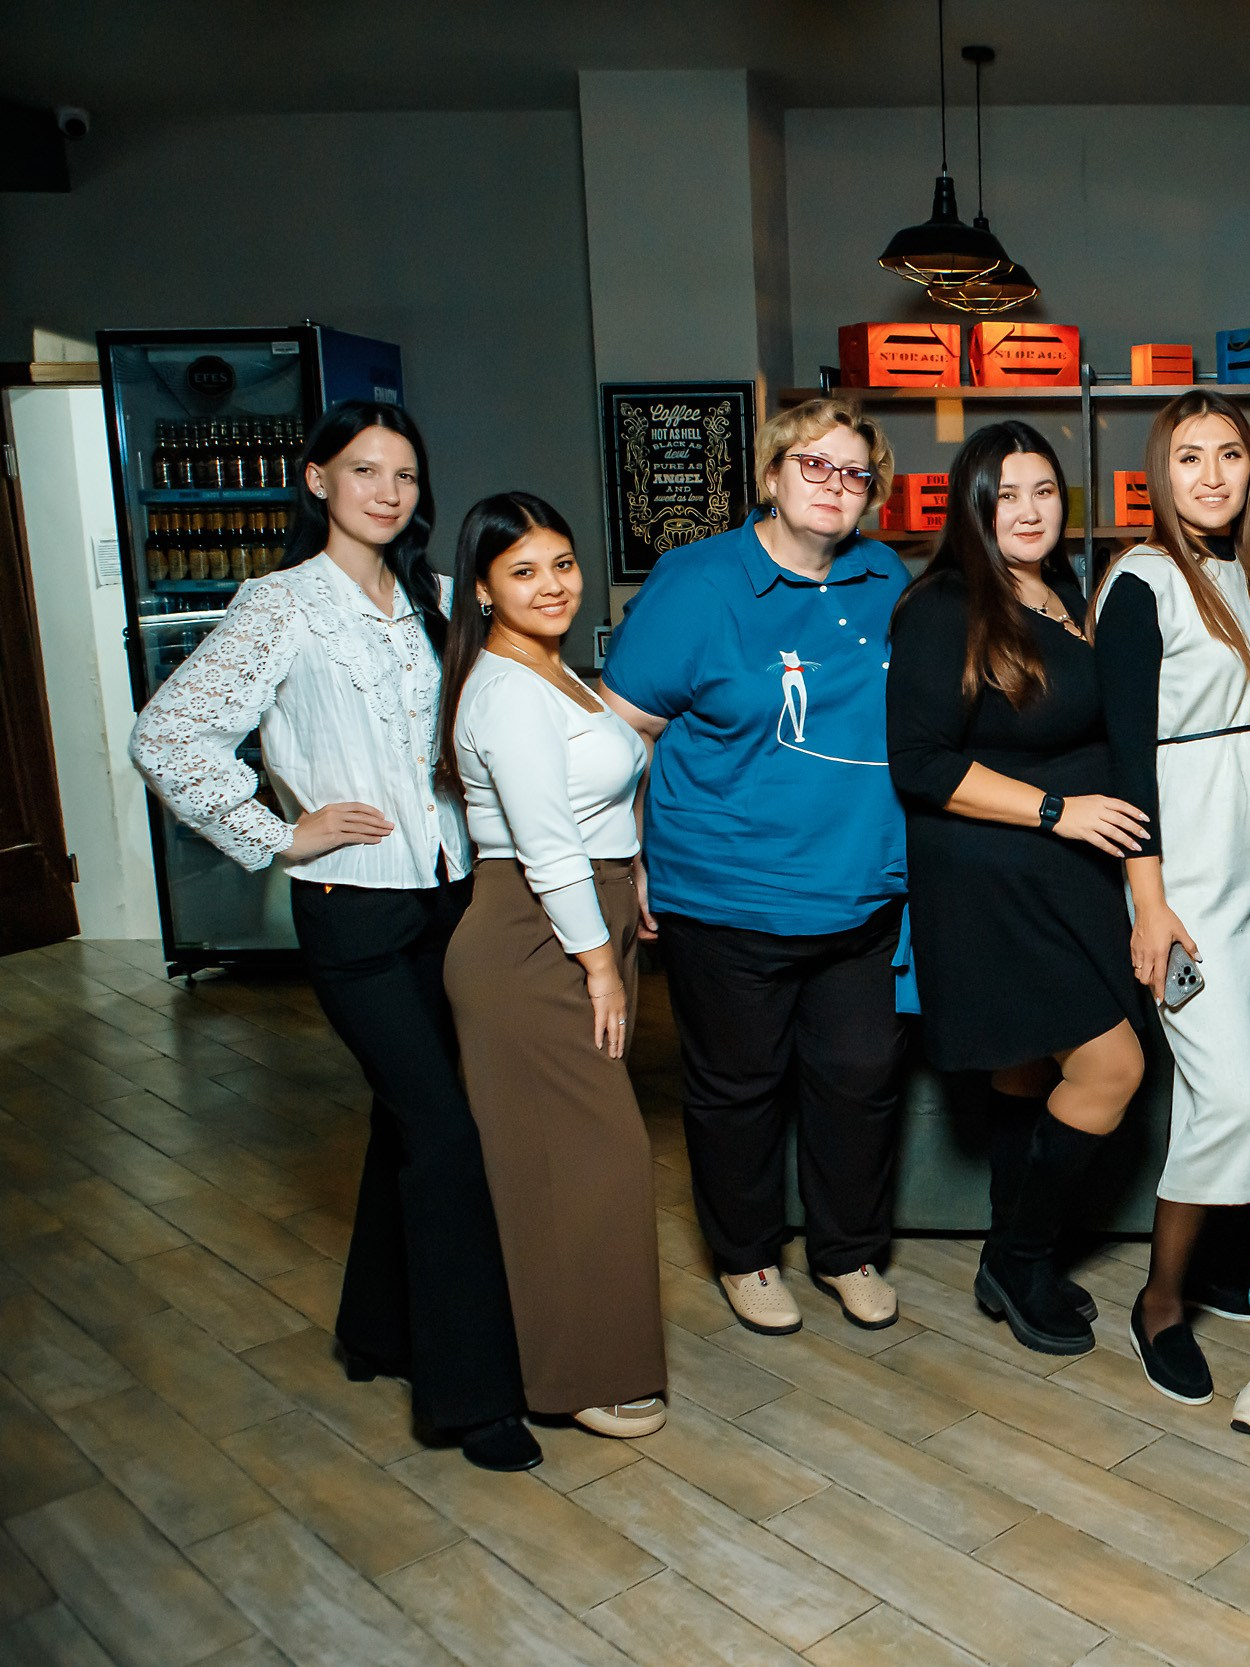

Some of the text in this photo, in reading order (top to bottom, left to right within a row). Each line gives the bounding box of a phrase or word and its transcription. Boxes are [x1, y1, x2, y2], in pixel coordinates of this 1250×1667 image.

[880, 352, 949, 363] STORAGE
[993, 350, 1067, 360] STORAGE
[194, 373, 228, 383] EFES
[650, 404, 702, 427] Coffee
[651, 428, 702, 440] HOT AS HELL
[652, 441, 702, 450] BLACK AS
[664, 448, 690, 459] devil
[652, 473, 704, 484] ANGEL
[926, 475, 947, 484] FOL
[665, 485, 692, 493] AND
[687, 493, 705, 502] love
